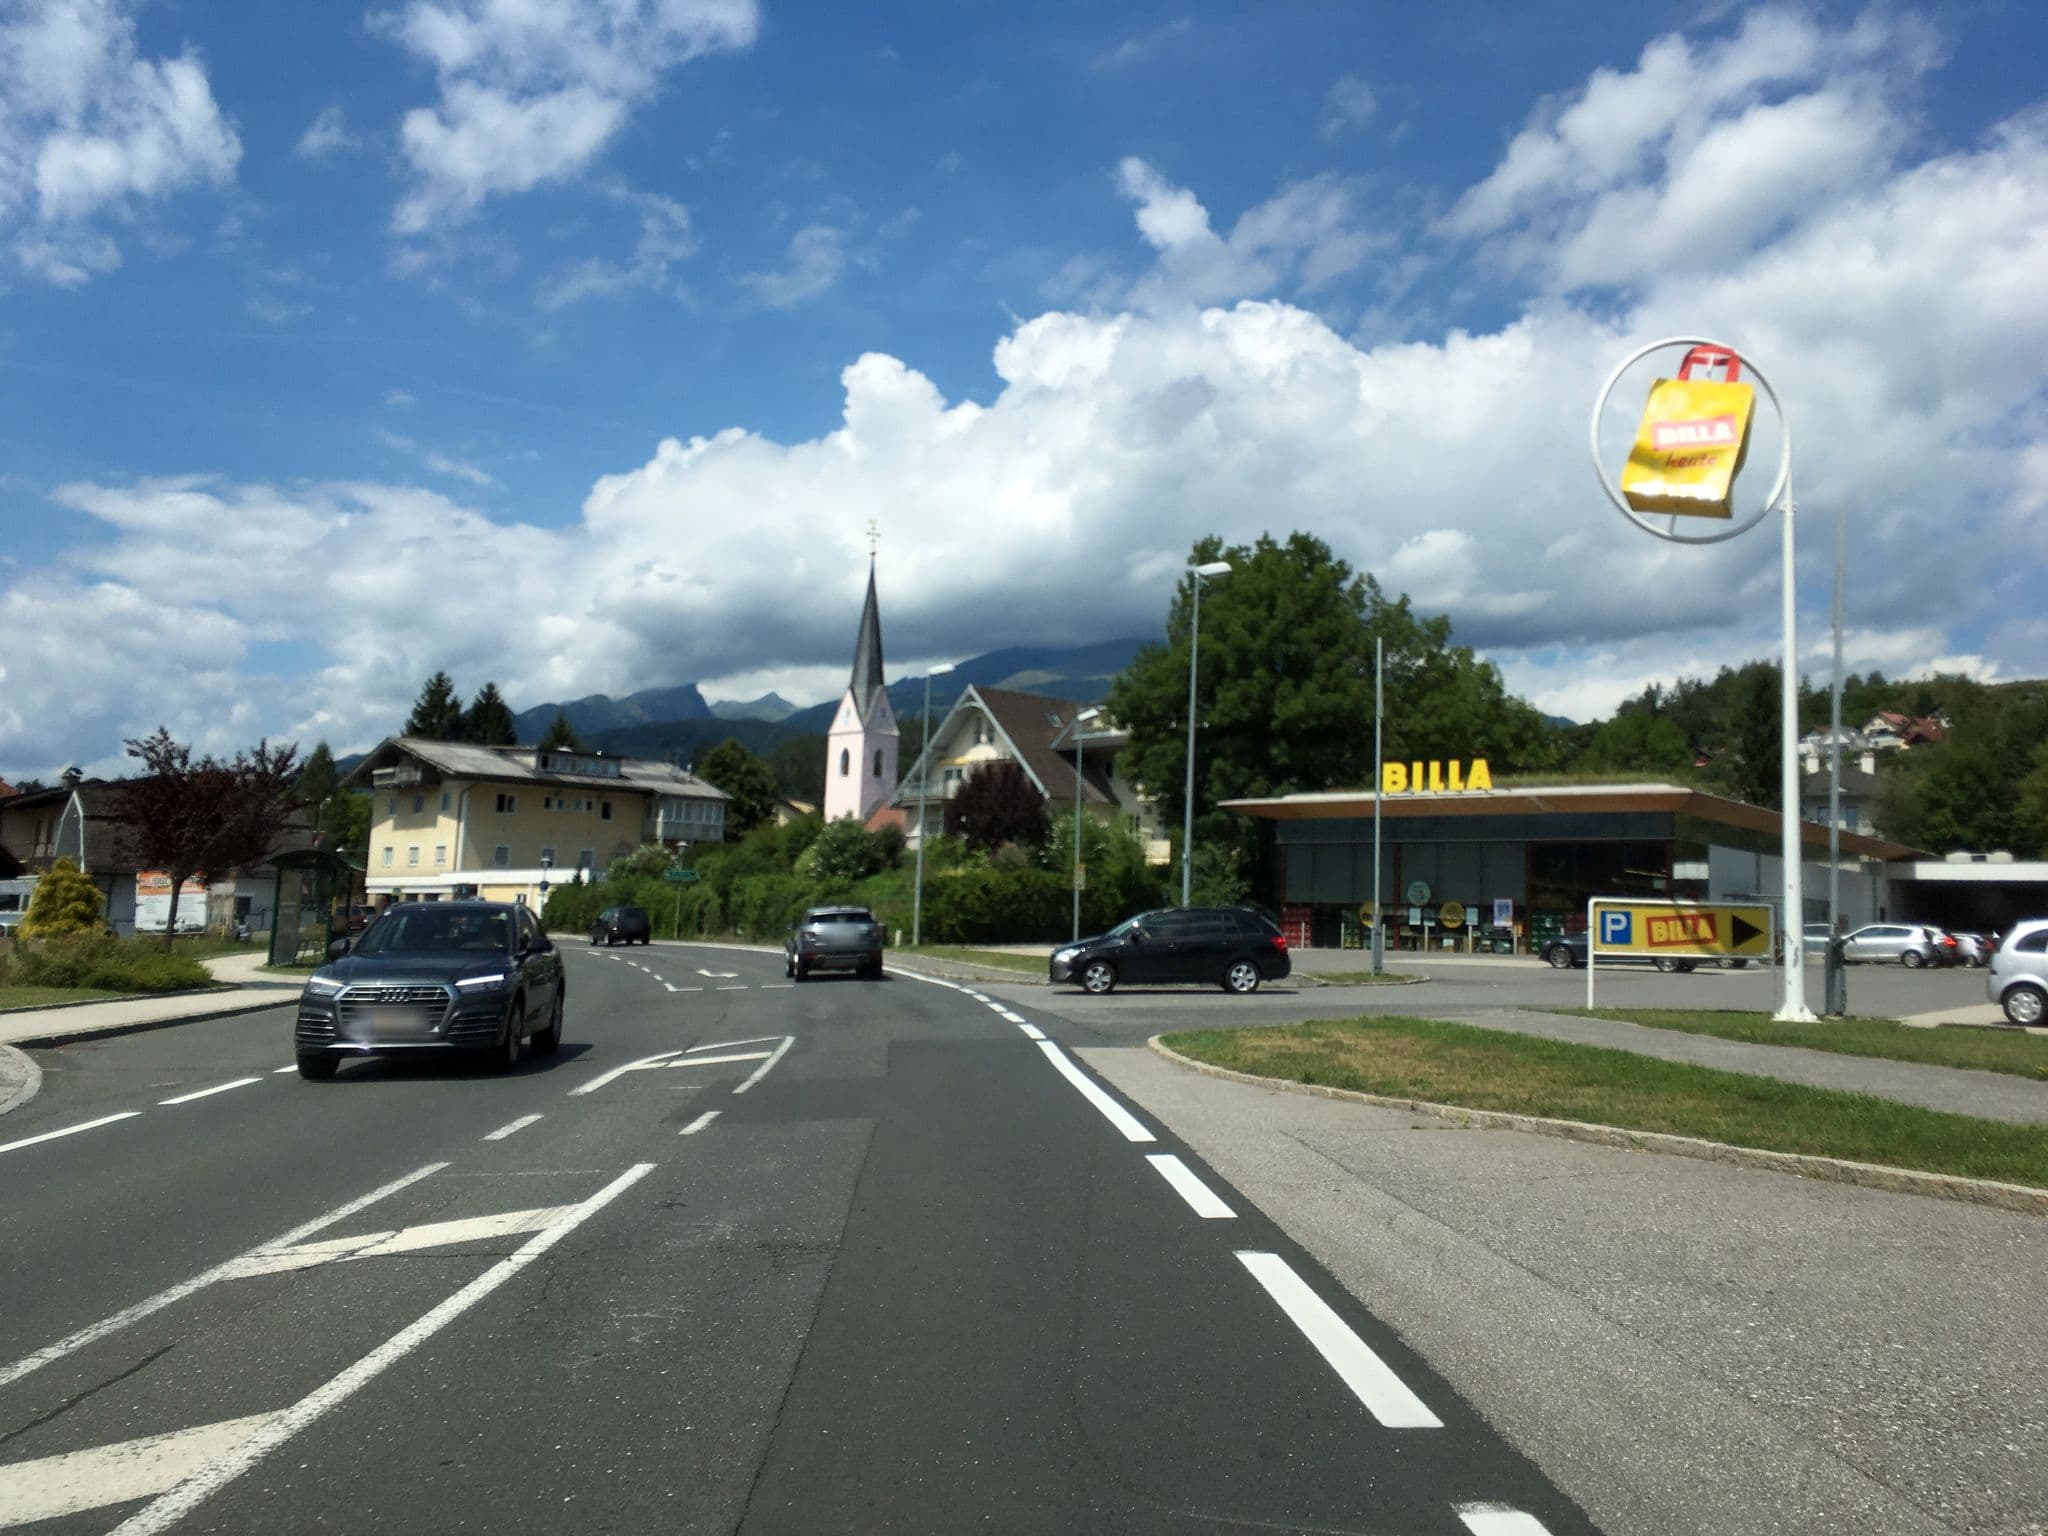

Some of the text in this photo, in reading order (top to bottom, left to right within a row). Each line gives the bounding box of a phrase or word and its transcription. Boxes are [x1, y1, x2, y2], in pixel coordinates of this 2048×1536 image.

[1657, 421, 1734, 445] BILLA
[1382, 758, 1493, 793] BILLA
[1605, 913, 1714, 943] P BILLA
